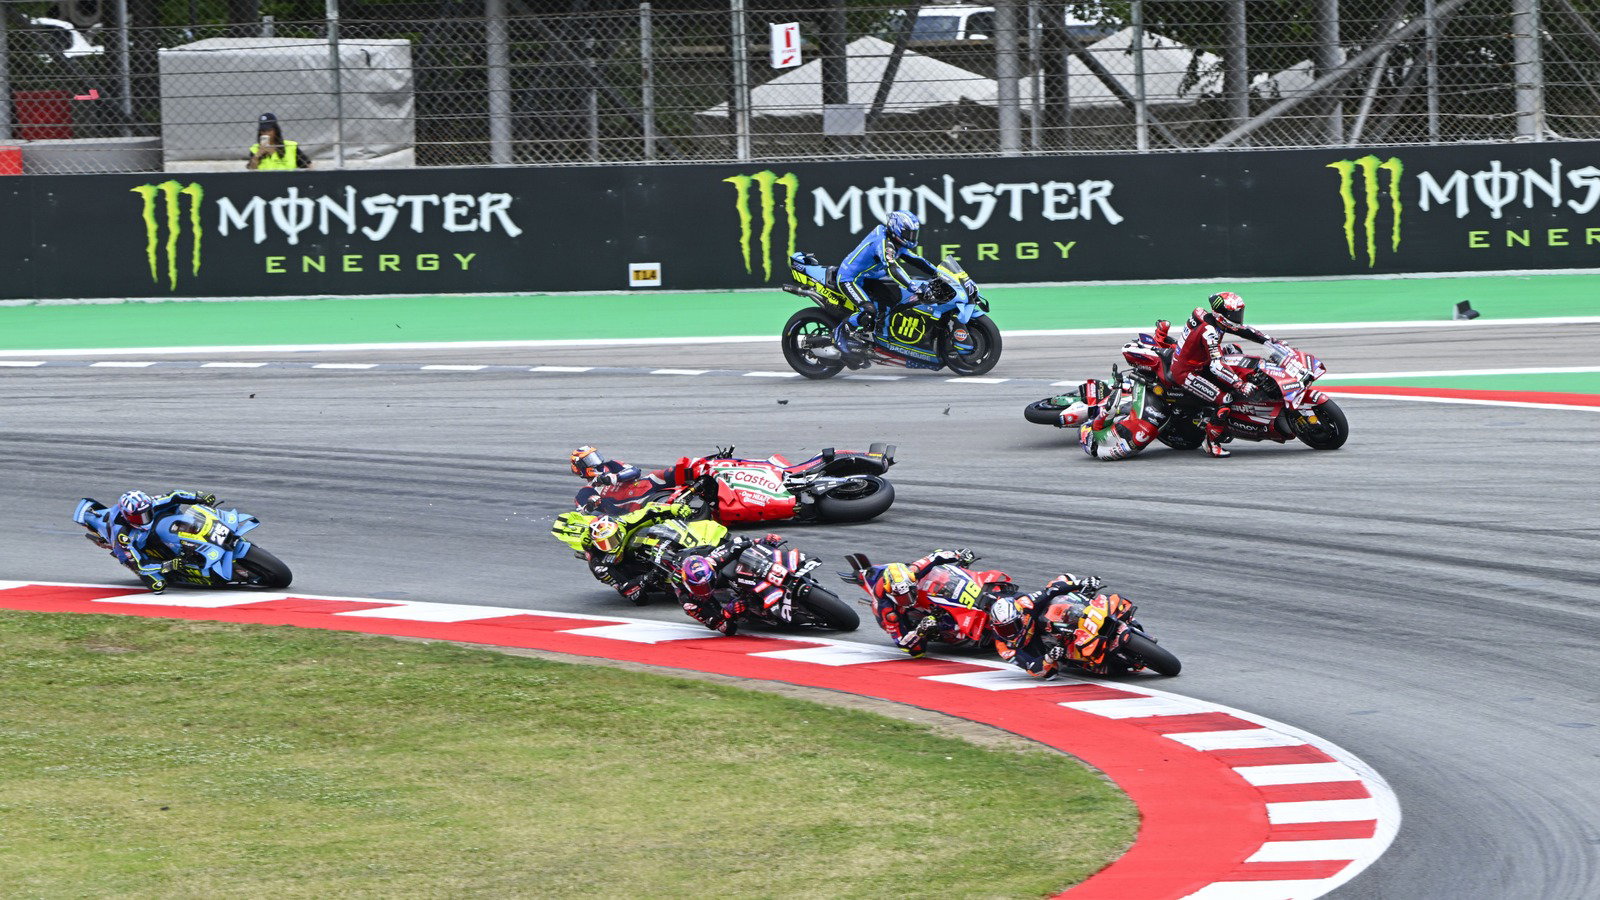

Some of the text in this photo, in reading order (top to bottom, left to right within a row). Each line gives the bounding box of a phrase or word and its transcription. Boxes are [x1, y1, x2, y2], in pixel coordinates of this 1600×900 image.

[216, 185, 522, 245] MONSTER
[812, 173, 1124, 235] MONSTER
[265, 252, 477, 273] ENERGY
[897, 241, 1076, 264] ERGY
[633, 269, 657, 281] T14
[1193, 380, 1215, 397] Lenovo
[735, 471, 782, 491] Castrol
[210, 523, 230, 546] 25
[766, 563, 789, 586] 89
[959, 580, 981, 610] 36
[1083, 608, 1103, 635] 37
